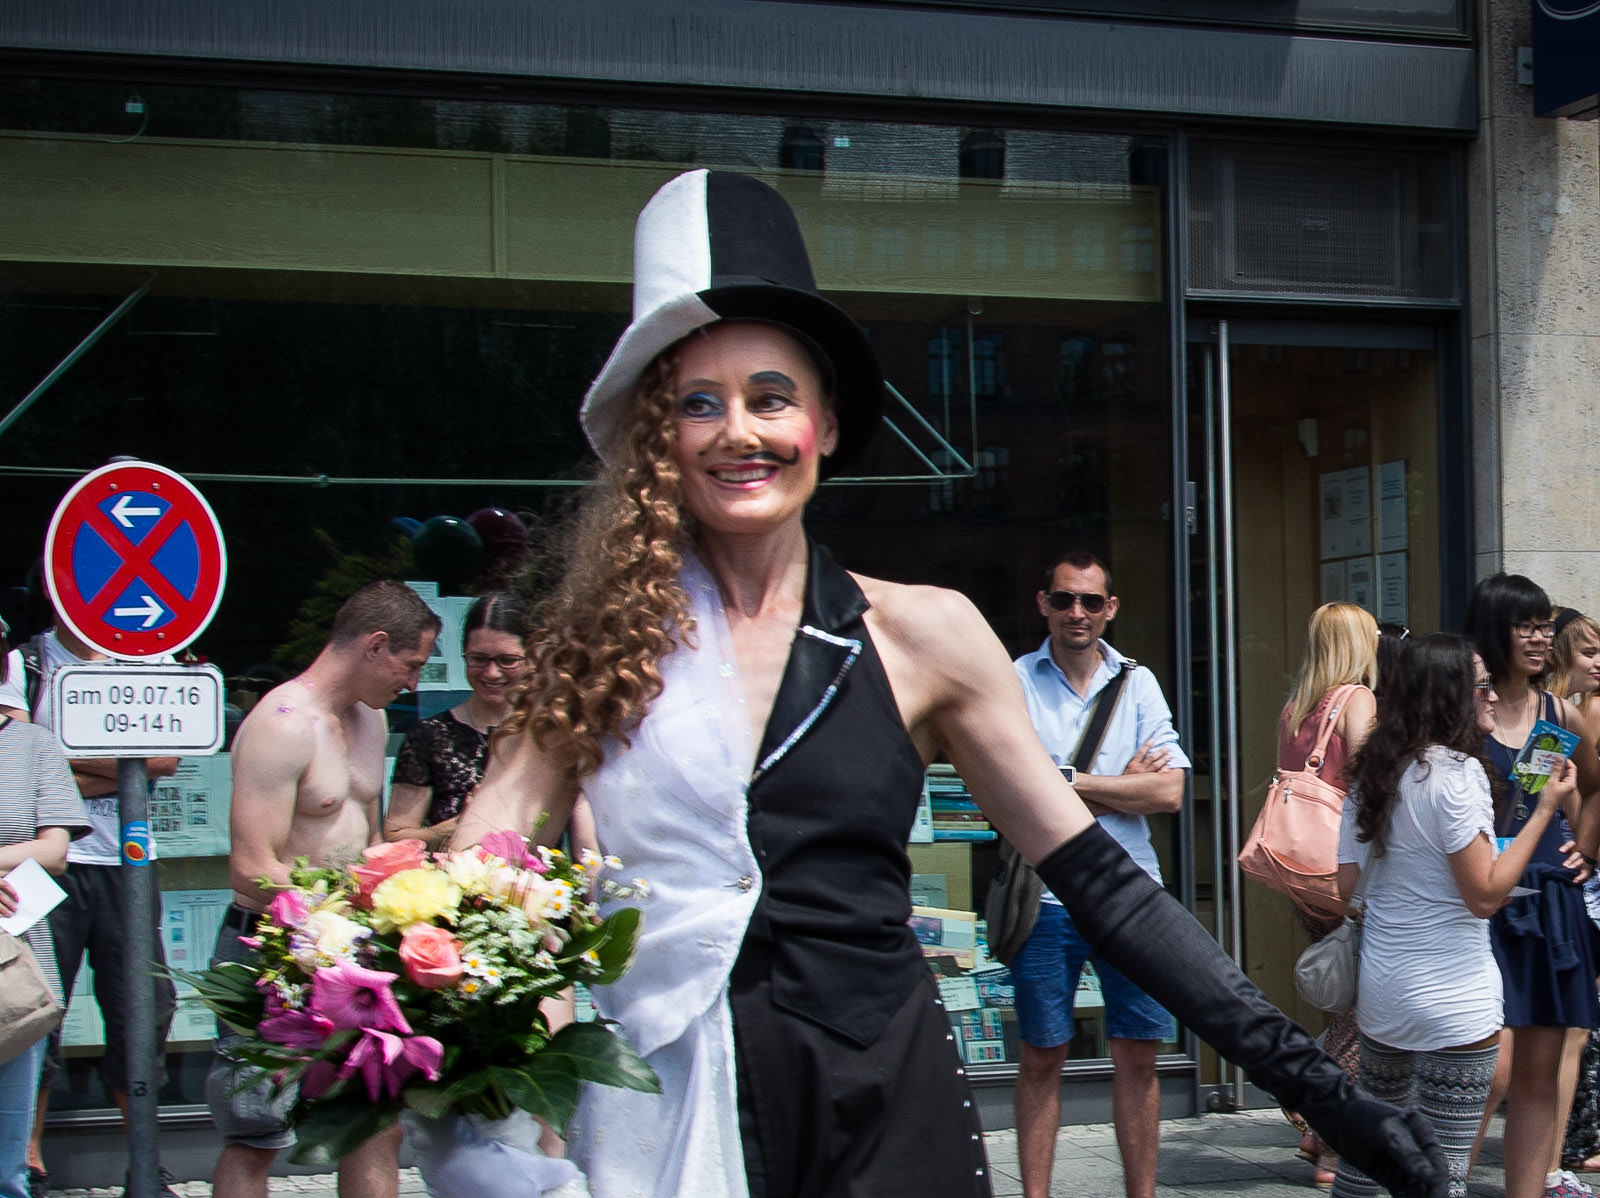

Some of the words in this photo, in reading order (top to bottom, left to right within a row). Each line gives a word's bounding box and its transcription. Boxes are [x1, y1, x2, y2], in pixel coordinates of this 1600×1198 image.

[66, 689, 102, 705] am
[110, 686, 199, 705] 09.07.16
[105, 714, 163, 732] 09-14
[170, 714, 182, 732] h
